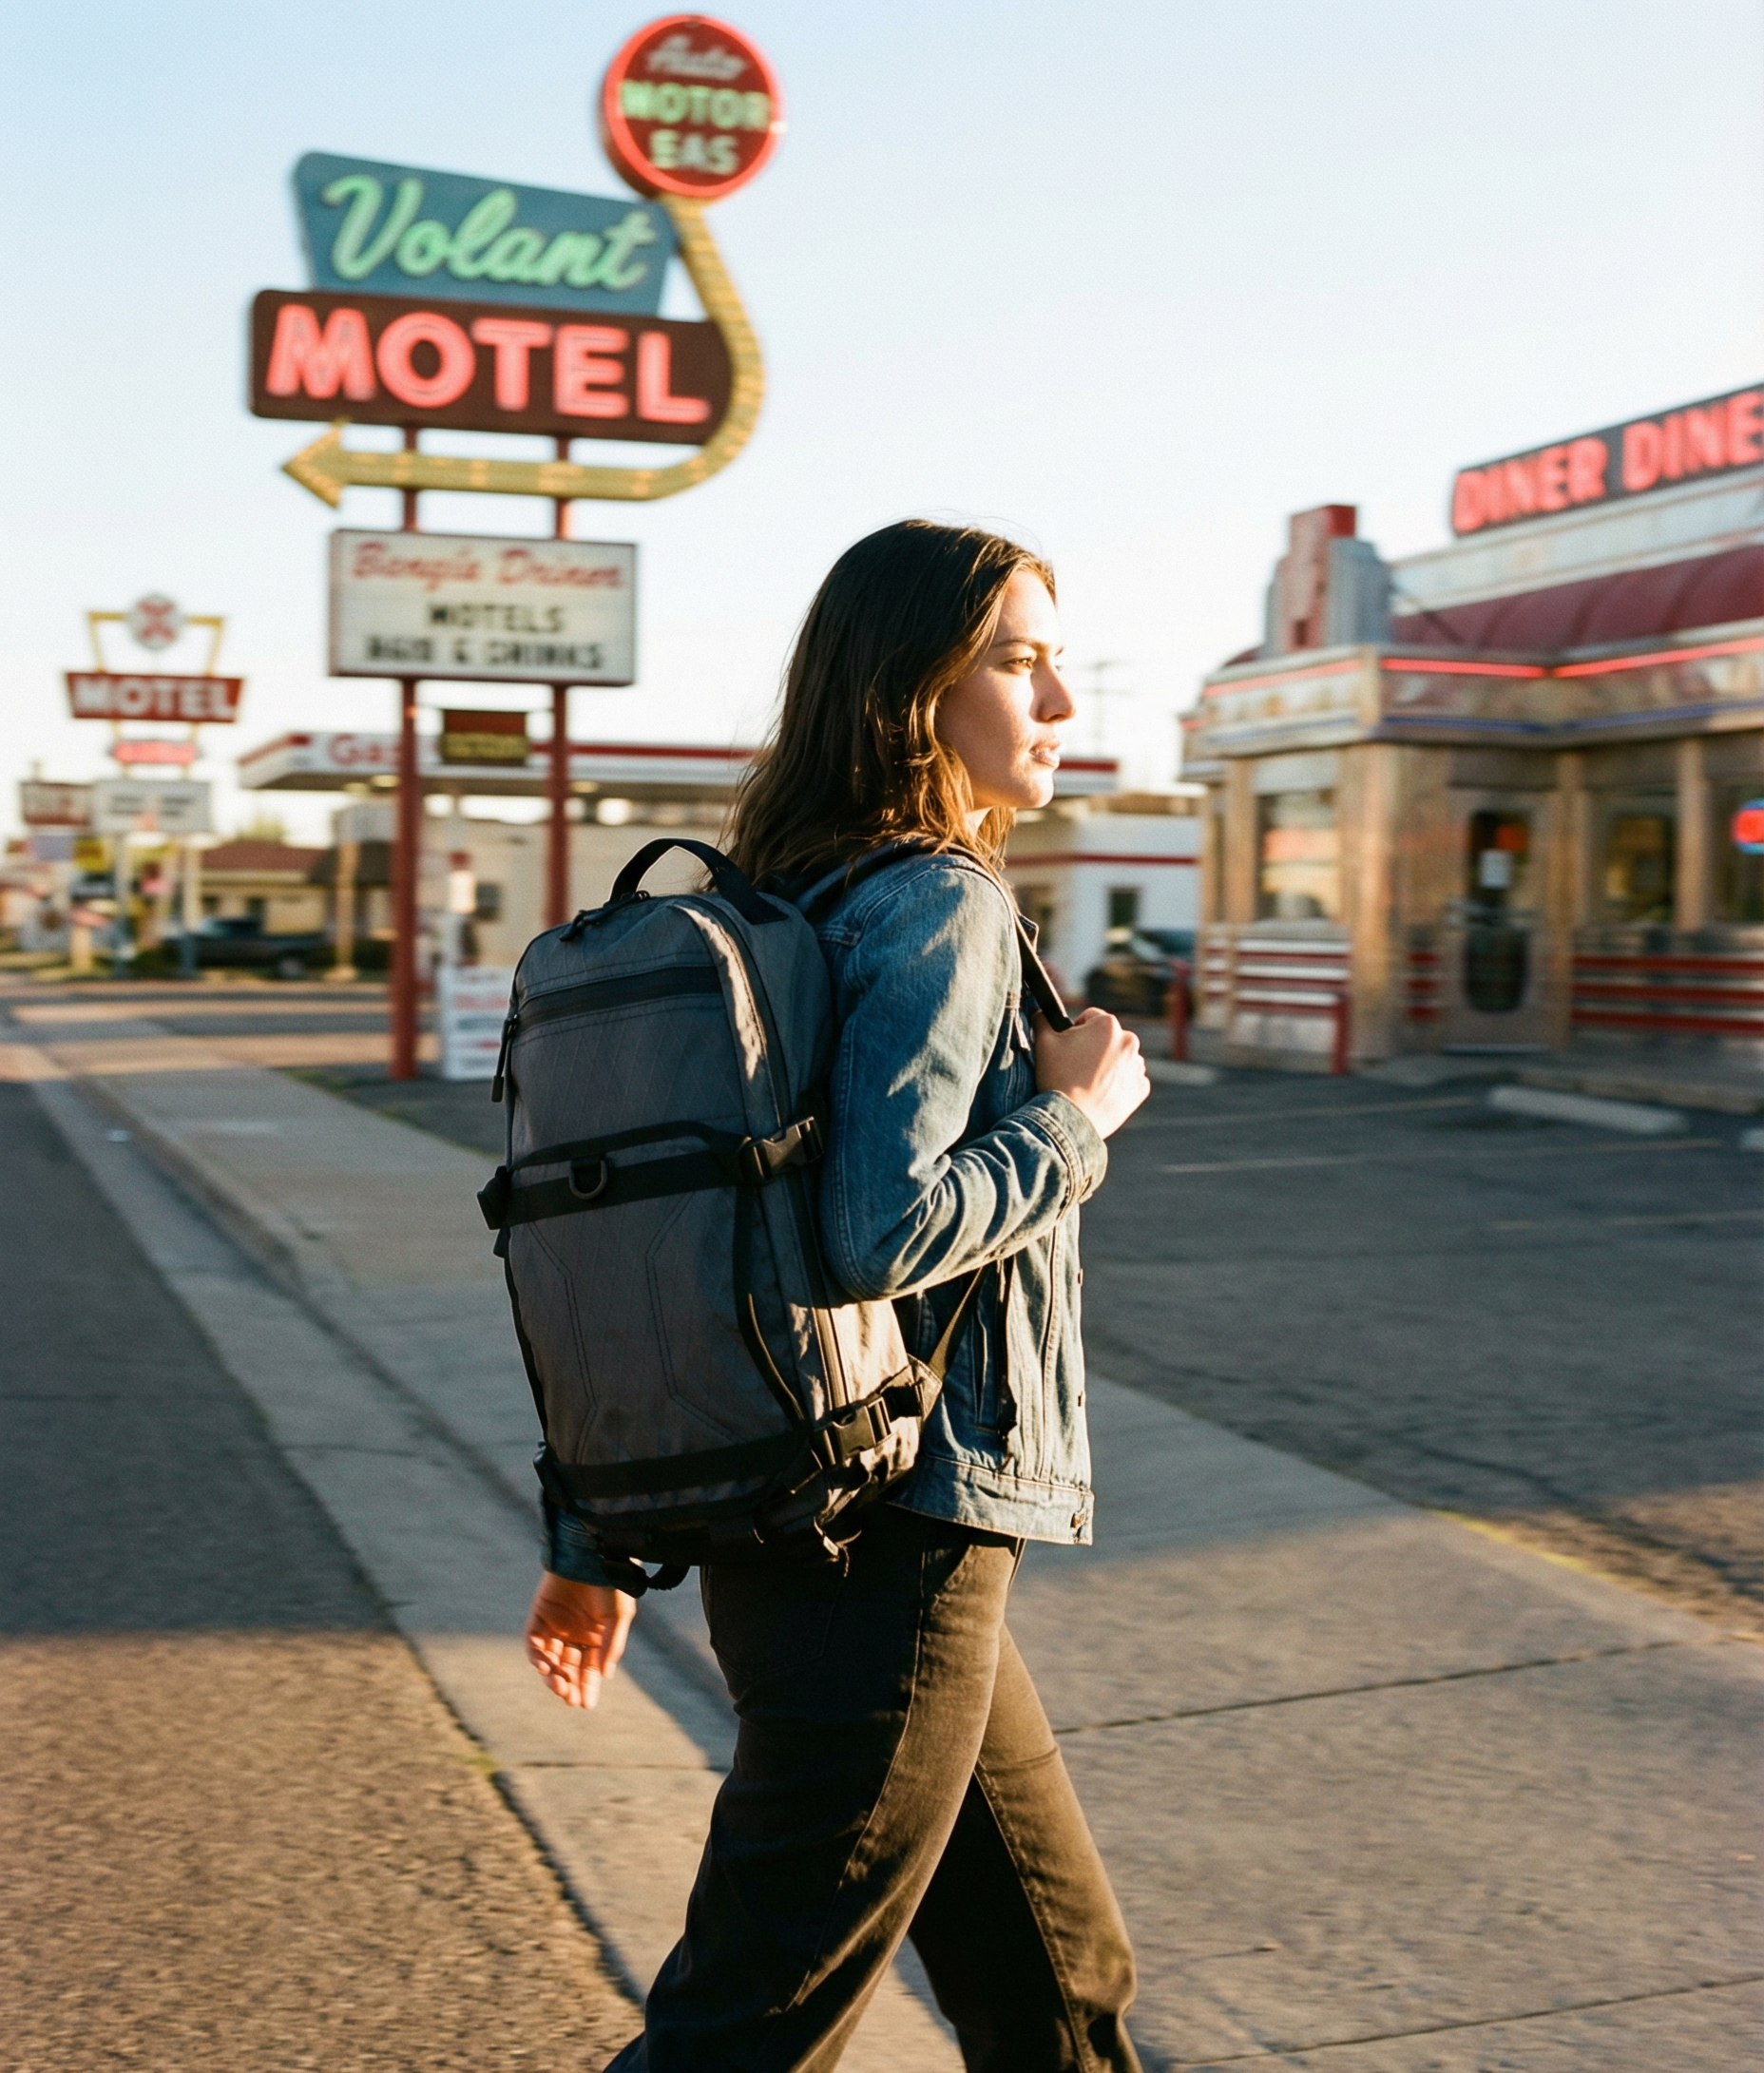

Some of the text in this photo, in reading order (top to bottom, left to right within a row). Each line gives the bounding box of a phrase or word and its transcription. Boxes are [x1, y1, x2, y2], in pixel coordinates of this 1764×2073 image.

[321, 174, 660, 290] Volant
[265, 303, 711, 425] MOTEL
[1451, 436, 1609, 533] DINER
[74, 676, 236, 720] MOTEL
